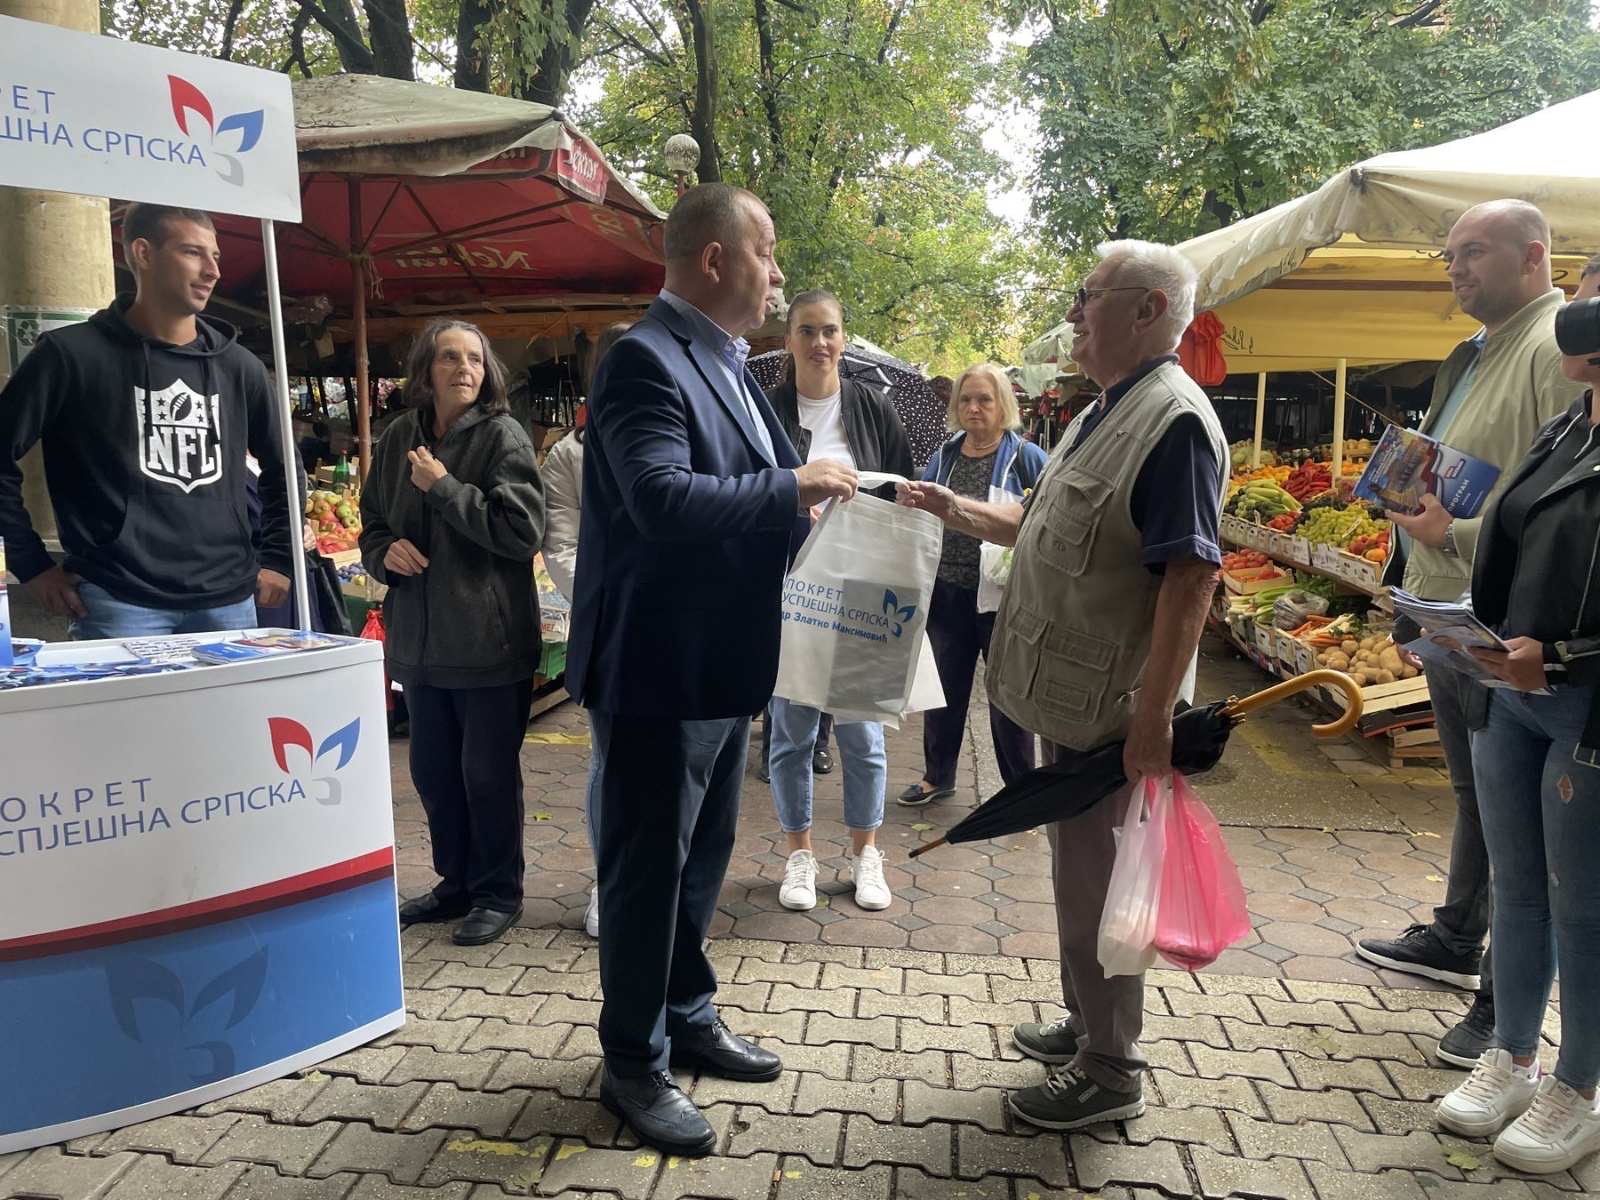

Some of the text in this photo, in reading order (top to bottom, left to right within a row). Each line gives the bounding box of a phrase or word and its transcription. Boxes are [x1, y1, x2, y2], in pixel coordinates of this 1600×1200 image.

[0, 84, 56, 114] ЕТ
[82, 128, 206, 167] СРПСКА
[147, 426, 215, 479] NFL
[785, 578, 846, 601] ПОКРЕТ
[782, 591, 889, 629] УСПЈЕШНА СРПСКА
[0, 777, 152, 823] ОКРЕТ
[0, 779, 306, 857] СПЈЕШНА СРПСКА
